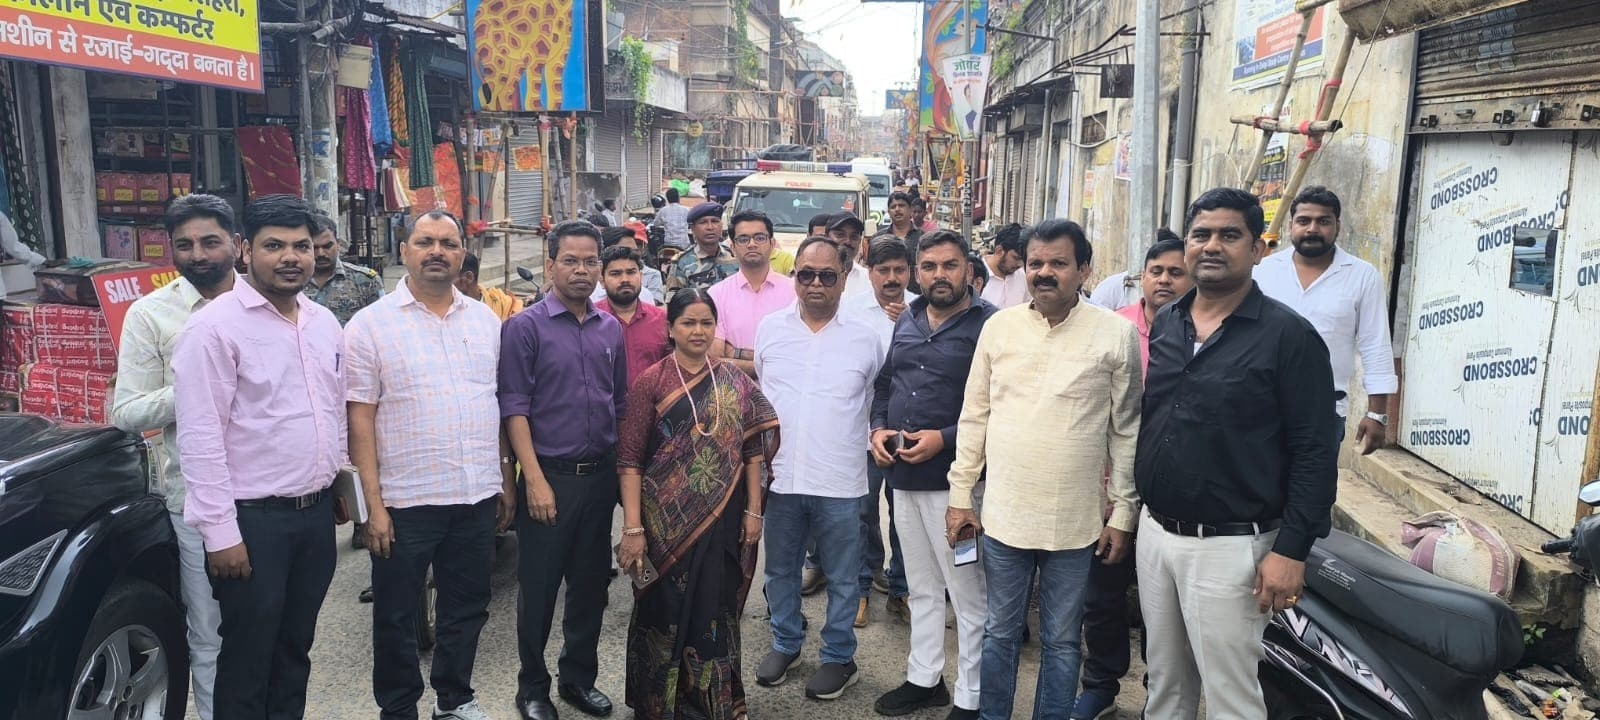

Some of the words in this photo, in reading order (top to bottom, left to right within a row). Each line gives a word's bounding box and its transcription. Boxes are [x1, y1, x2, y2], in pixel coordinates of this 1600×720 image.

[135, 5, 214, 40] कम्फर्टर
[57, 24, 78, 54] से
[193, 53, 233, 77] बनता
[1431, 167, 1498, 210] CROSSBOND
[1477, 211, 1555, 252] CROSBOND
[104, 277, 143, 303] SALE
[1419, 300, 1484, 330] CROSSBOND
[1463, 356, 1538, 382] CROSSBOND
[1411, 429, 1470, 445] CROSSBOND
